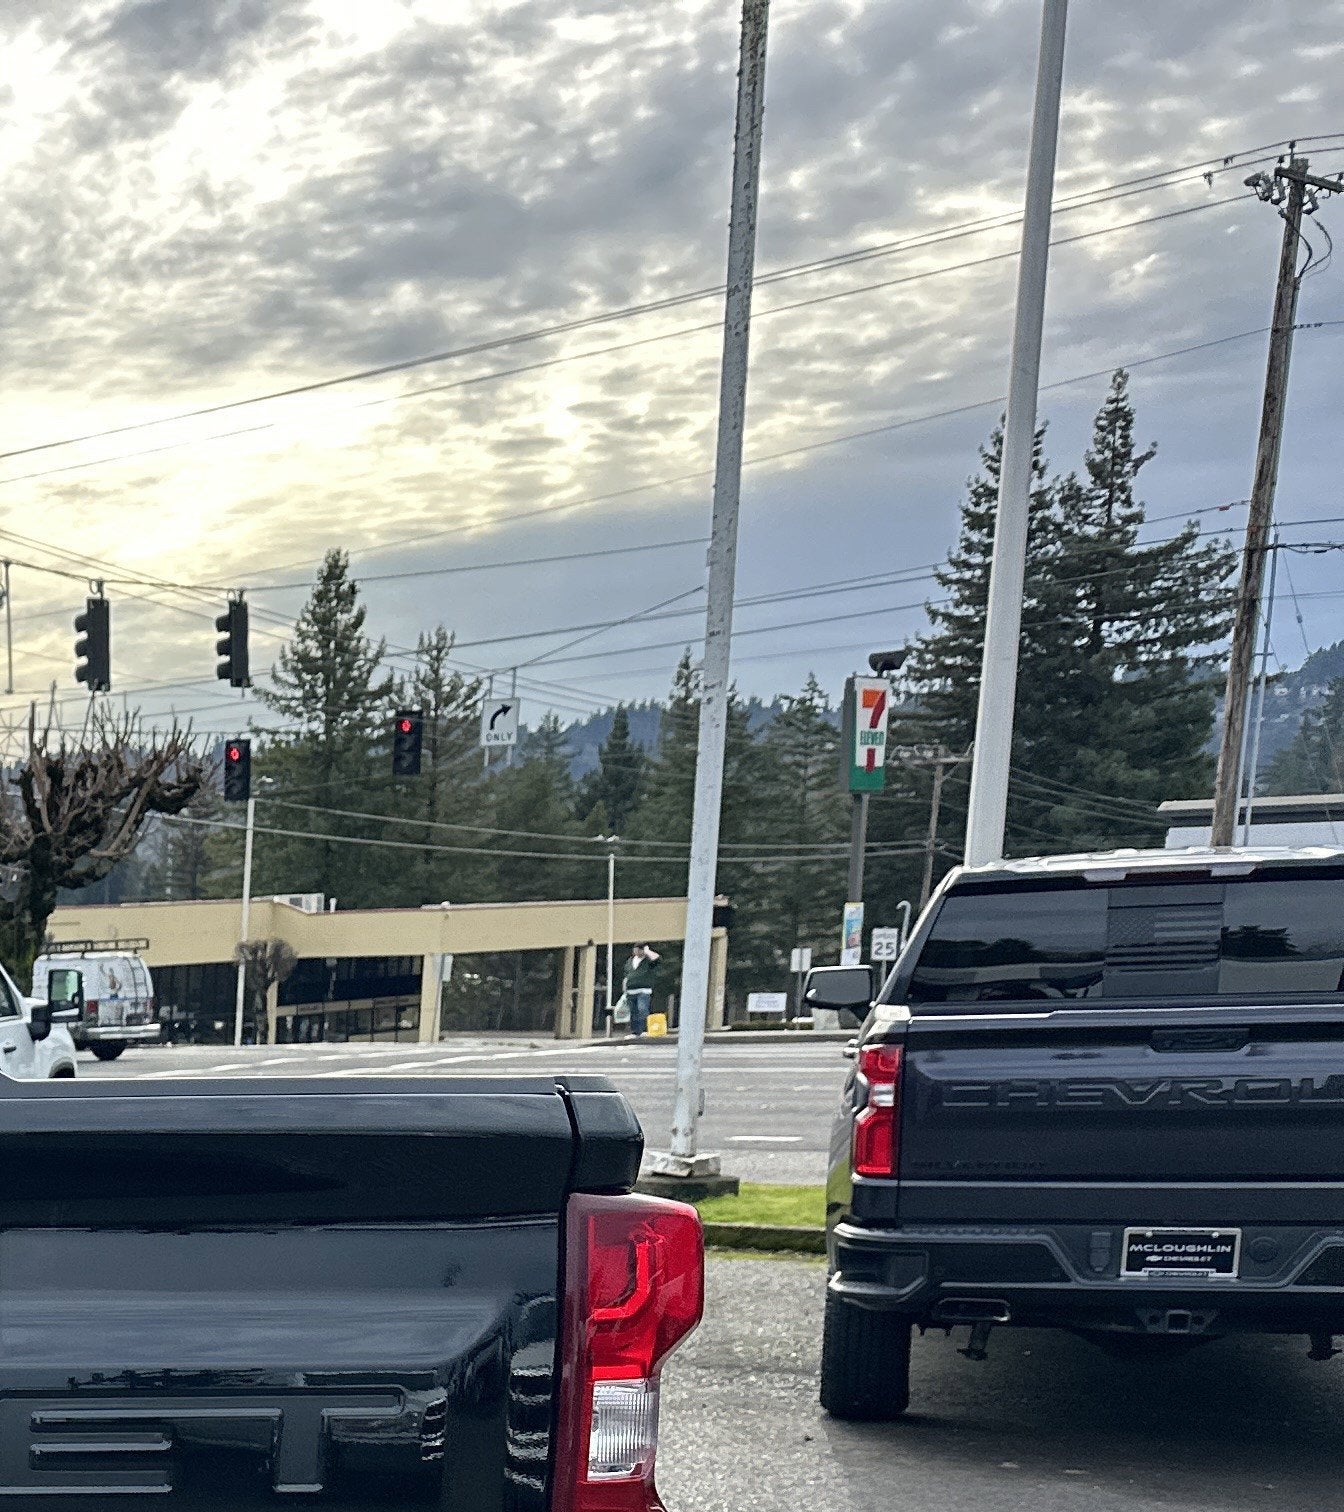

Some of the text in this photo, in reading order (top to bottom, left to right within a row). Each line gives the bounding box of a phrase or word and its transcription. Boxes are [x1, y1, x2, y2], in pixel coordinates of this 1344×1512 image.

[485, 732, 513, 742] ONLY
[874, 941, 895, 957] 25
[1129, 1243, 1232, 1253] MCLOUGHLIN
